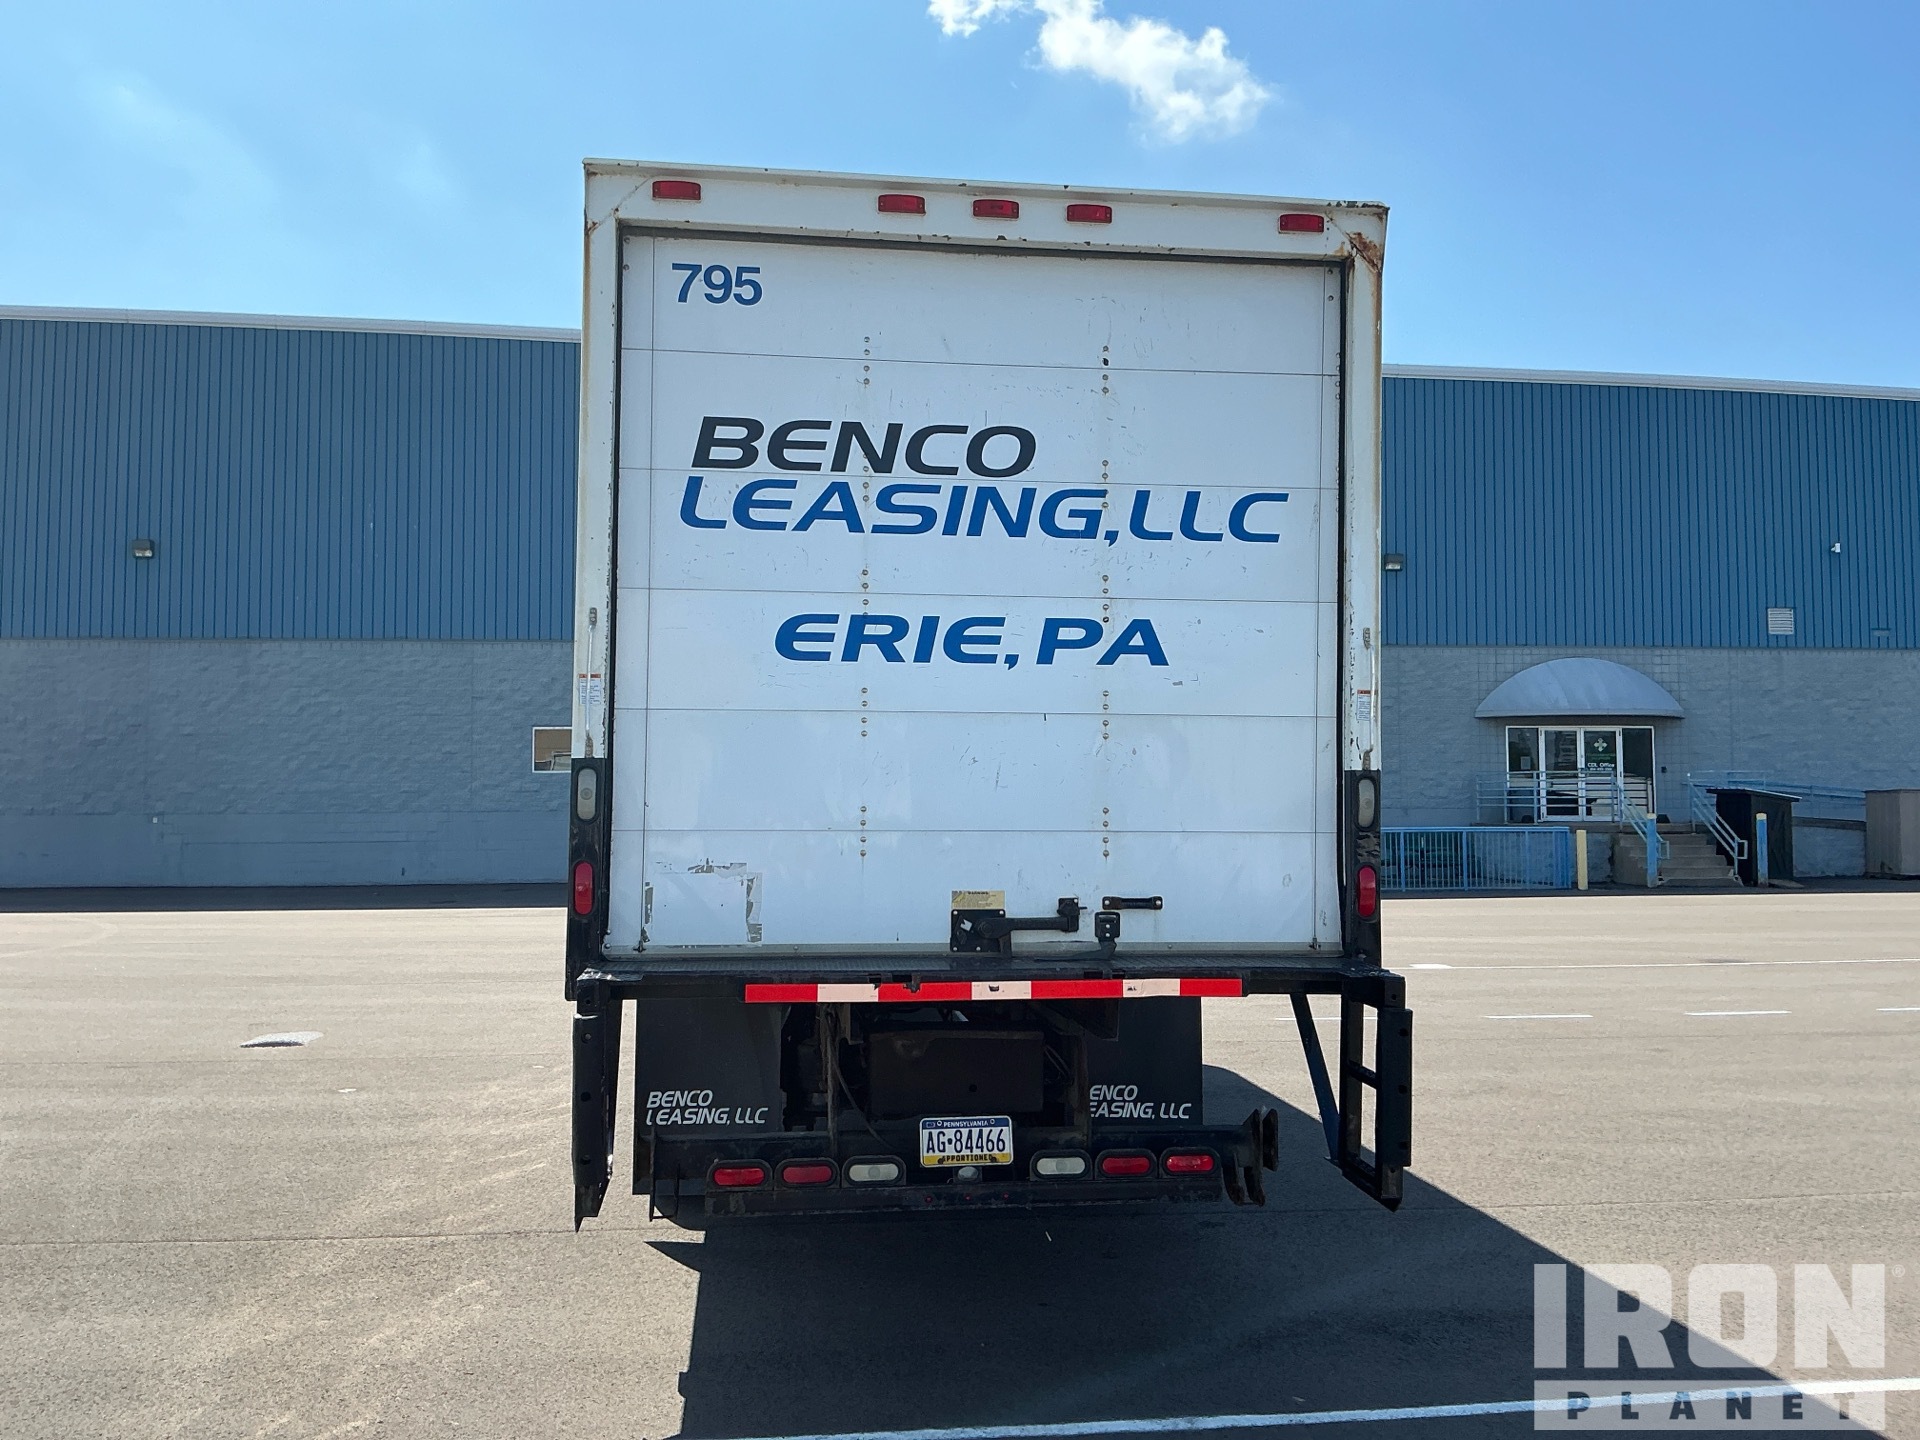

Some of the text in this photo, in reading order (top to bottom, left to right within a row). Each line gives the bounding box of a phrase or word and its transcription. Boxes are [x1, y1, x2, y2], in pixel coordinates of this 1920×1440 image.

[672, 263, 762, 305] 795
[691, 416, 1036, 477] BENCO
[646, 1089, 714, 1109] BENCO
[1089, 1084, 1139, 1101] ENCO
[734, 1107, 769, 1124] LLC
[1159, 1102, 1192, 1119] LLC
[943, 1120, 989, 1128] PENNSYLVANIA
